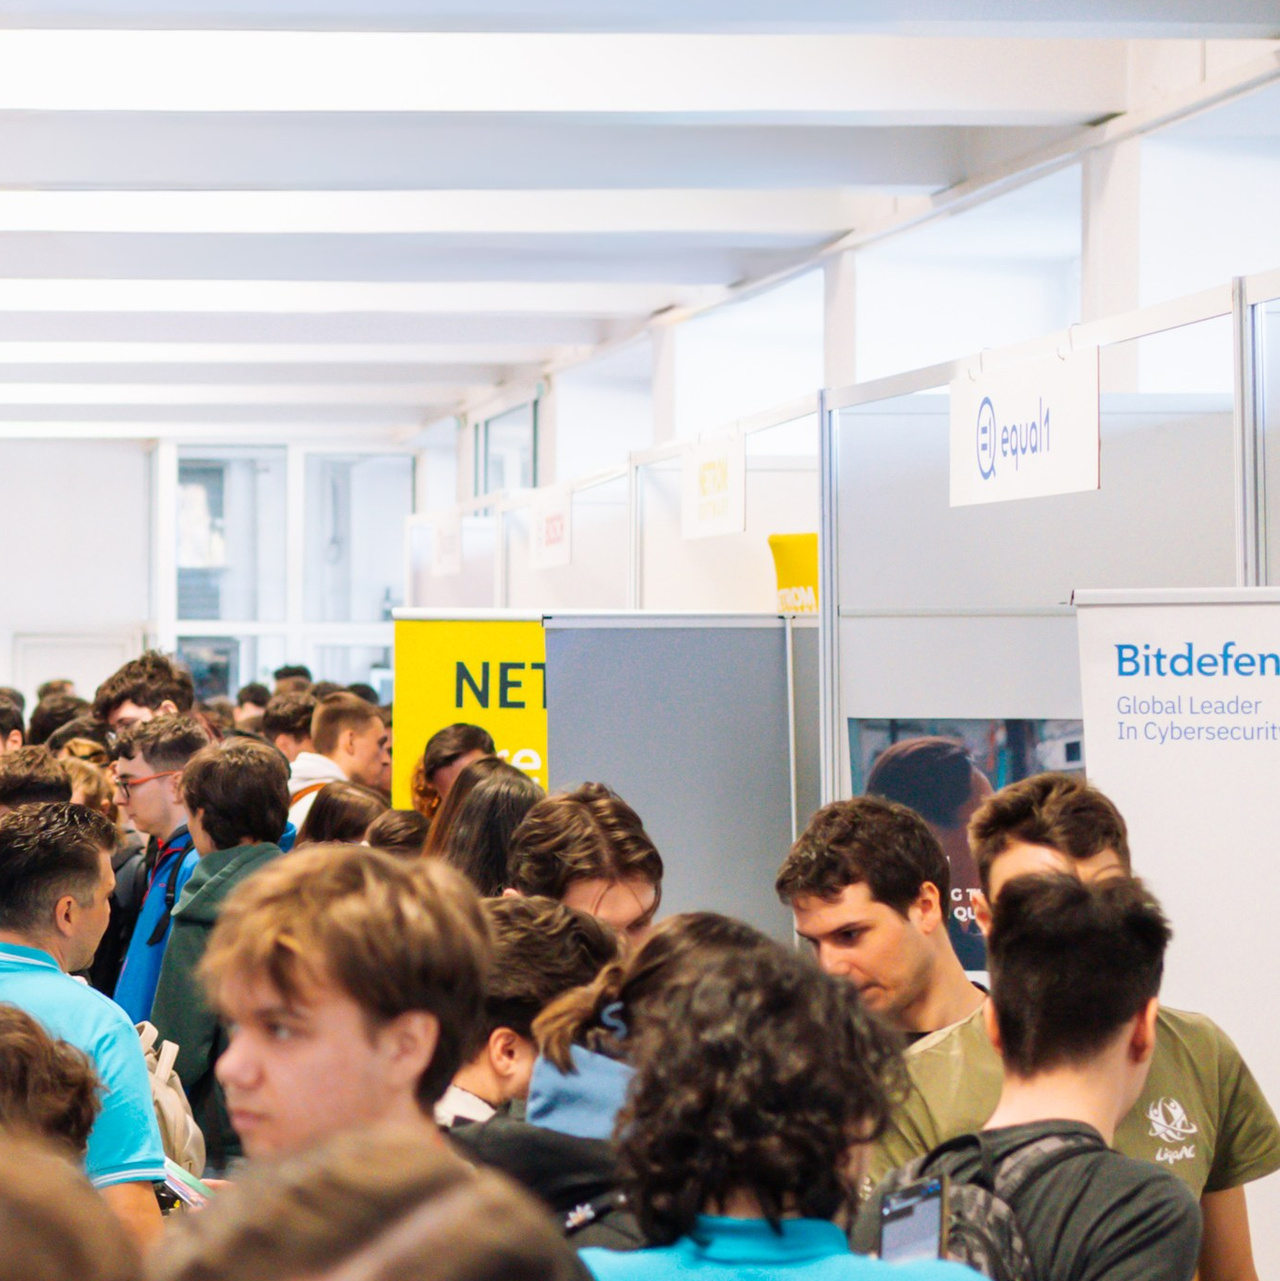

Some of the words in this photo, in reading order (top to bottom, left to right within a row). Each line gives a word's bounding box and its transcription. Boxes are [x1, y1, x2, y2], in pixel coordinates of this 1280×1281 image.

[1001, 396, 1050, 471] equal1
[1114, 641, 1280, 677] Bitdefen
[1117, 695, 1182, 715] Global
[1190, 695, 1262, 715] Leader
[1118, 721, 1137, 740] In
[1144, 721, 1280, 745] Cybersecurit
